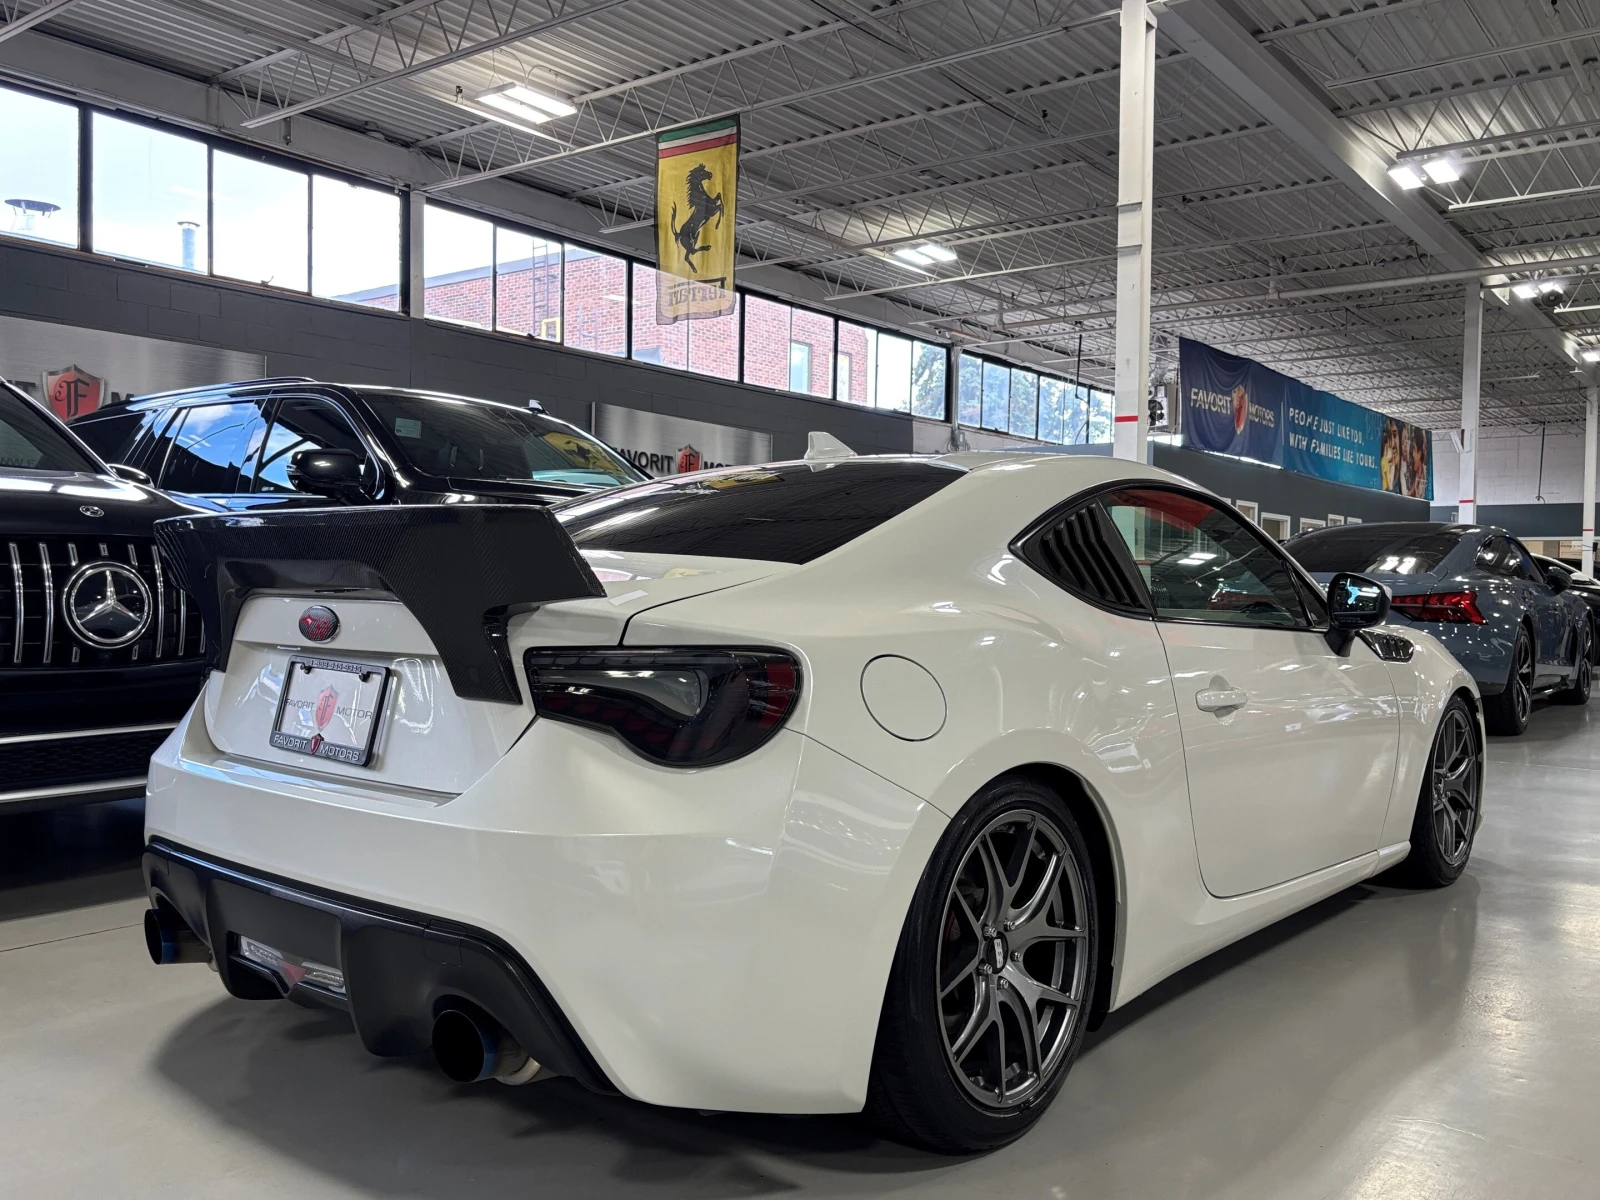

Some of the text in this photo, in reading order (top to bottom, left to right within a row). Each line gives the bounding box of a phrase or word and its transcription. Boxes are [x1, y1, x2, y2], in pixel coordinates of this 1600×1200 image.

[1190, 387, 1275, 428] FAVORIT MOTORS
[1319, 418, 1335, 436] JUST
[1337, 423, 1350, 440] LIKE
[1289, 431, 1308, 451] WITH
[1310, 438, 1341, 460] FAMILIES
[274, 734, 360, 761] FAVORIT MOTORS
